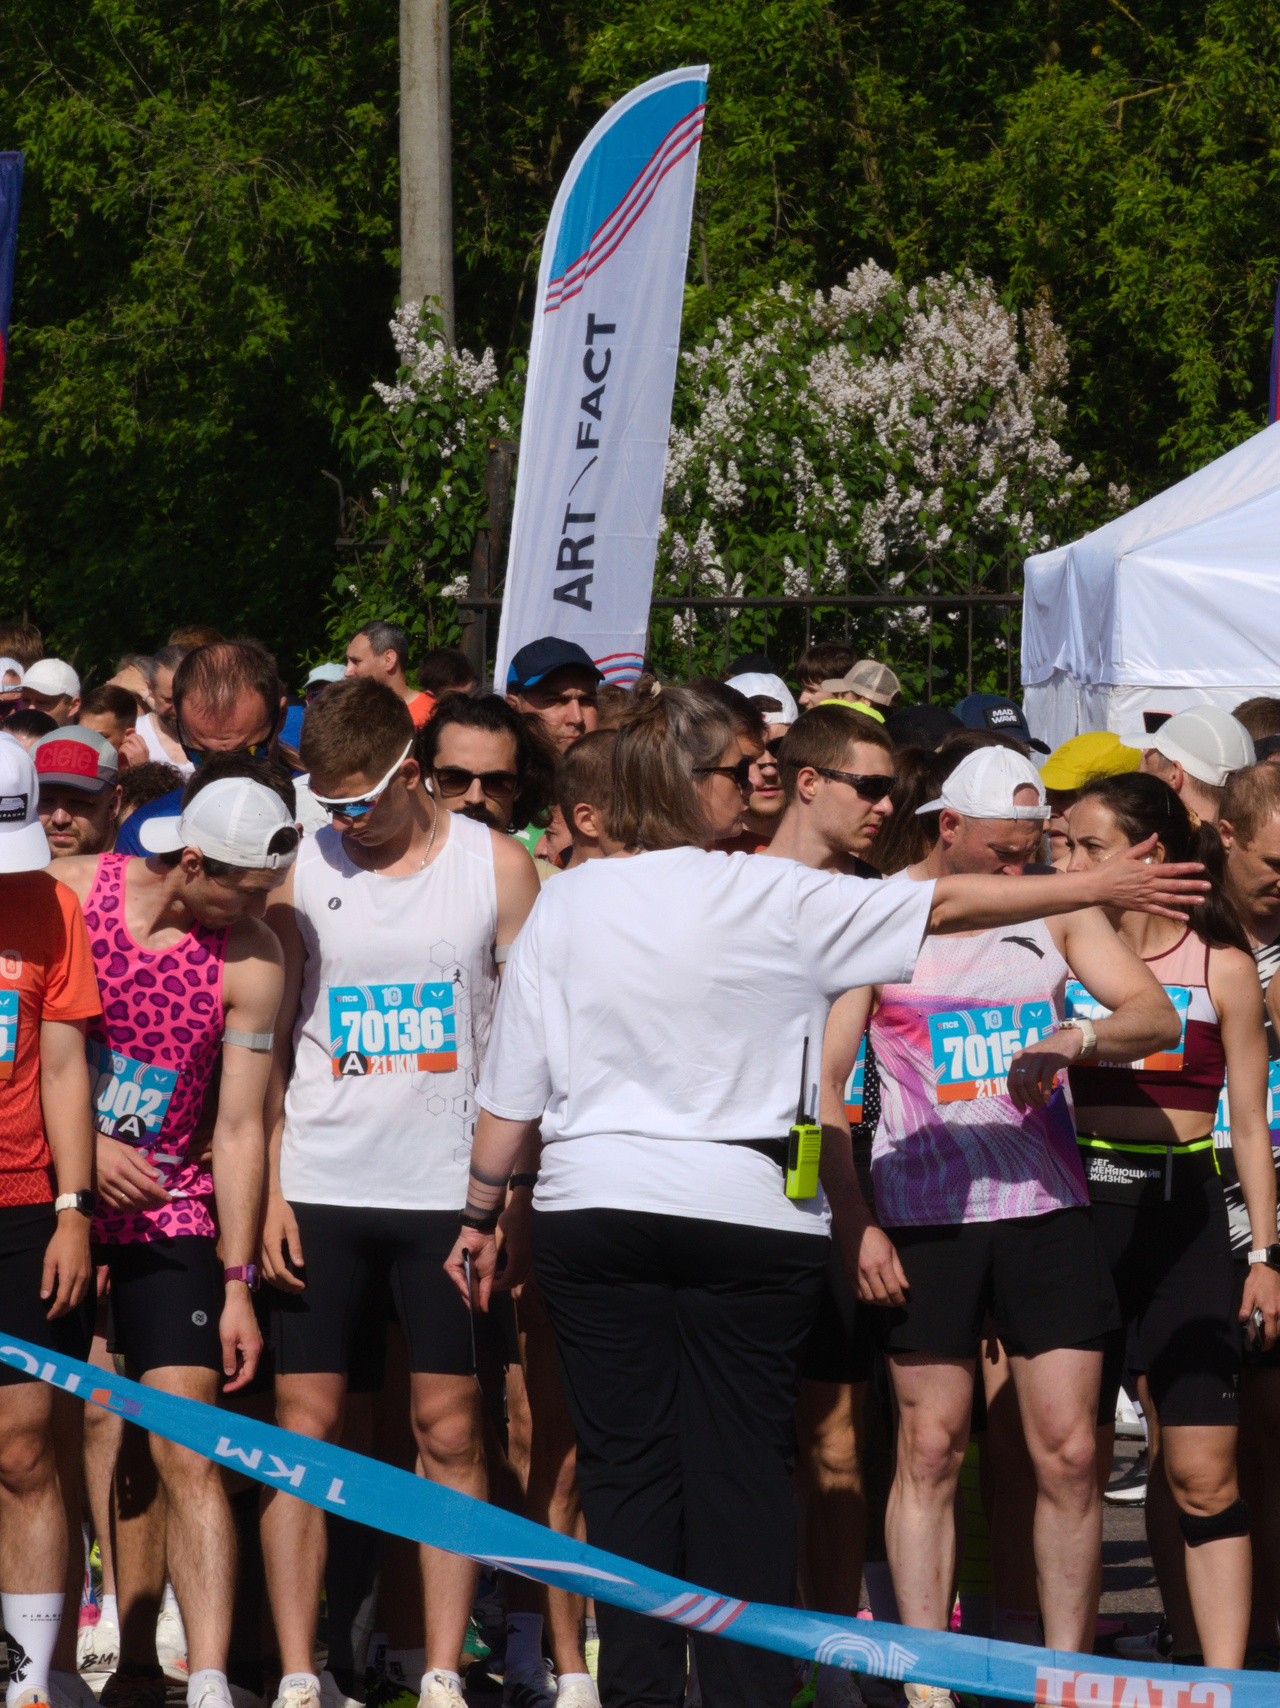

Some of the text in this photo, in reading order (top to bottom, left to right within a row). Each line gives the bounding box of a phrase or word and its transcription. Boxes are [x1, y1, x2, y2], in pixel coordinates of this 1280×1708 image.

[991, 715, 1017, 724] WAVE
[992, 708, 1014, 717] MAD
[40, 743, 92, 771] ciele
[341, 1006, 444, 1053] 70136
[342, 1053, 365, 1074] A
[118, 1115, 140, 1138] A
